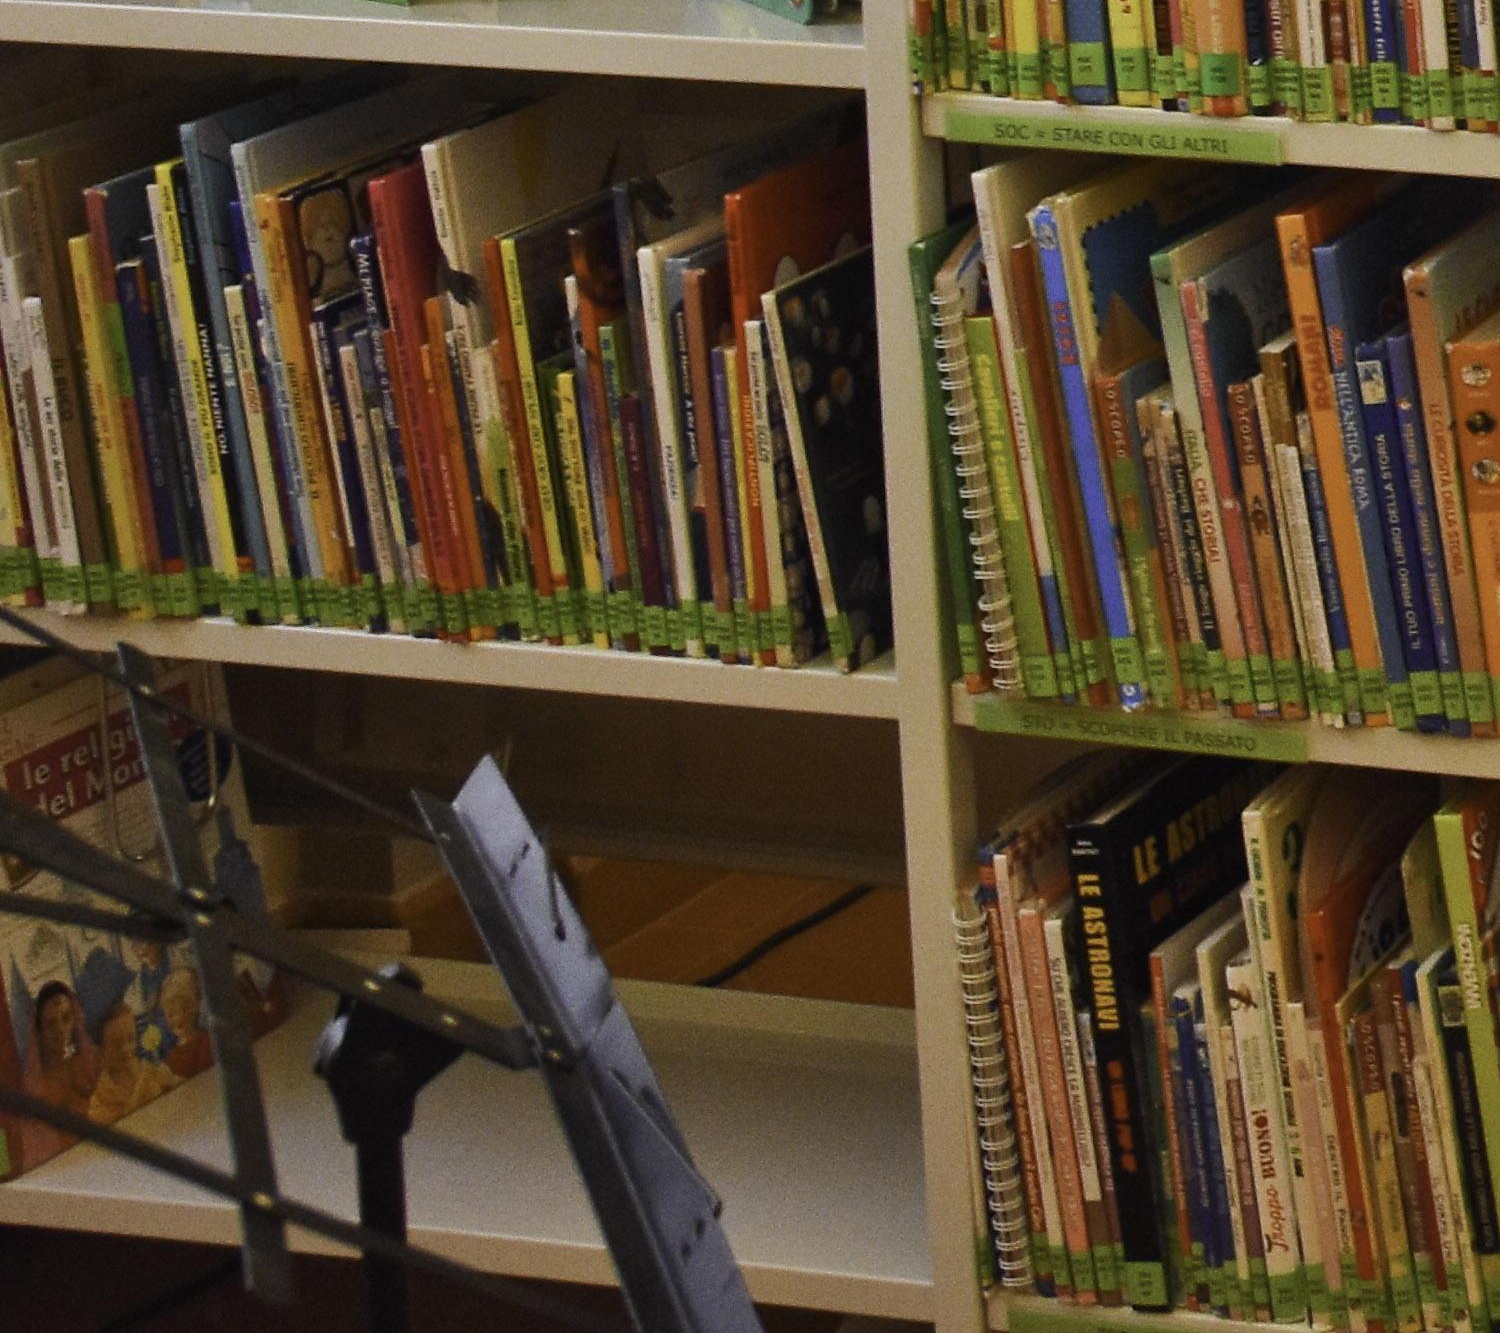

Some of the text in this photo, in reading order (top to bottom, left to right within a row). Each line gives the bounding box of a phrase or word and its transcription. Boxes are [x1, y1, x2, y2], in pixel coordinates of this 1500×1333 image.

[994, 123, 1228, 154] SOC STARE CON GLI ALTRI
[1374, 433, 1393, 479] STORIA
[1382, 482, 1401, 523] DELLA
[1390, 525, 1408, 564] LIBRO
[1397, 567, 1415, 607] PRIMO
[1184, 729, 1256, 751] PASSATO
[1077, 873, 1121, 1031] LE ASTRONAVI
[1250, 1108, 1276, 1179] BUONO!
